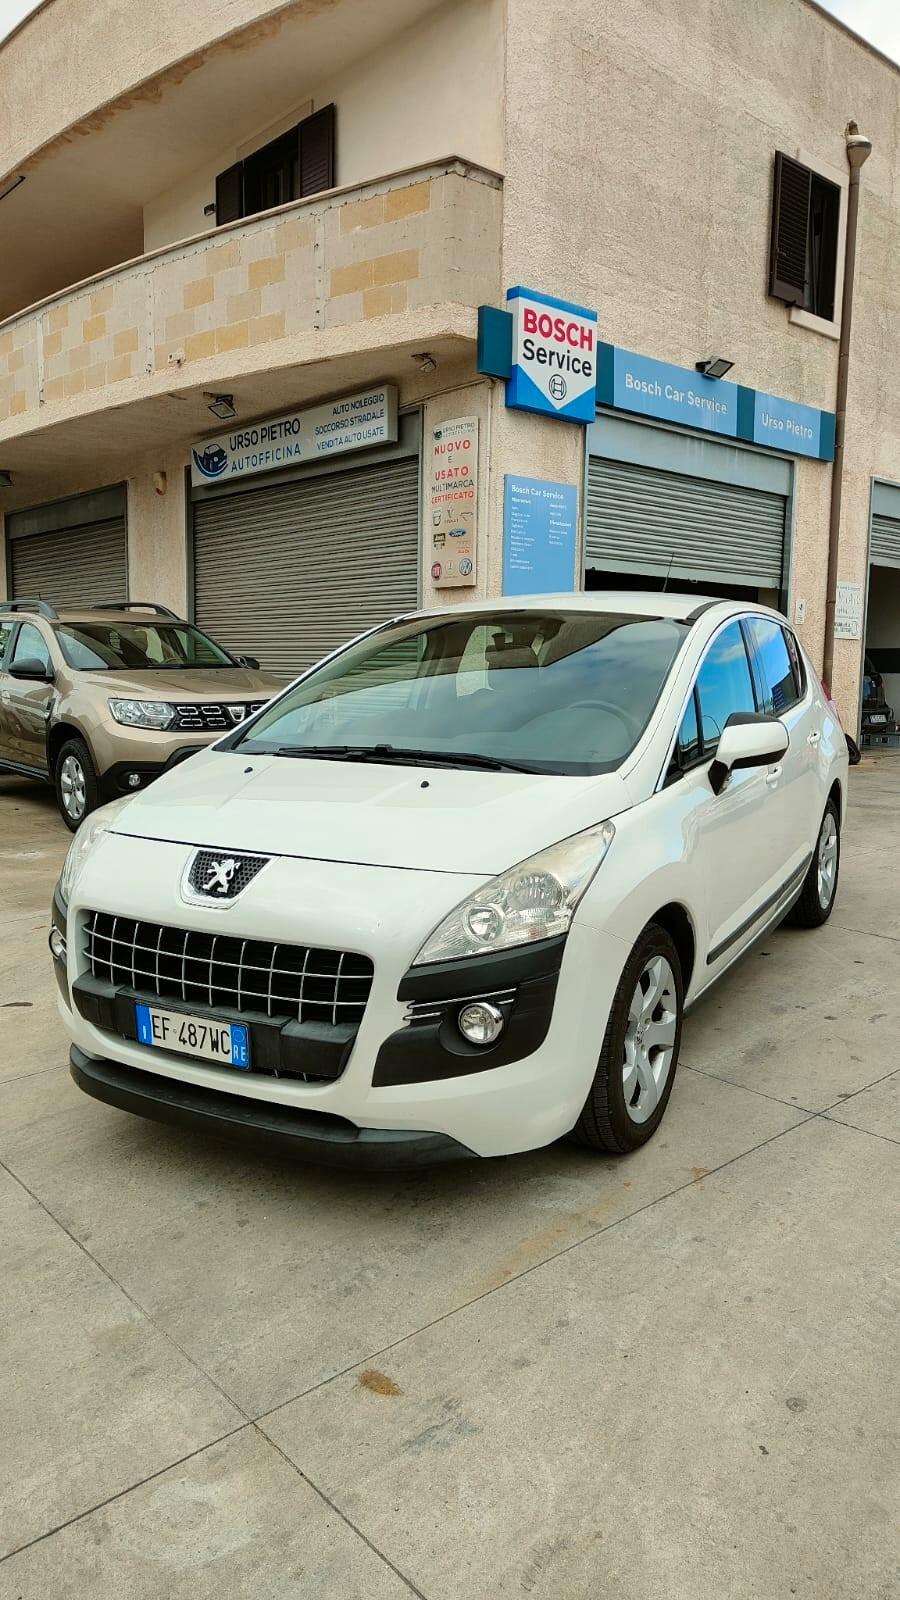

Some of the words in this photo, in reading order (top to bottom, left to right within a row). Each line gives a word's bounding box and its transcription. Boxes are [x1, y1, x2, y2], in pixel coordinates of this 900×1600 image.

[523, 308, 593, 352] BOSCH
[522, 338, 593, 378] Service
[332, 403, 350, 416] AUTO
[350, 393, 385, 411] NOLEGGIO
[624, 373, 662, 397] Bosch
[664, 384, 685, 403] Car
[687, 391, 729, 415] Service
[229, 430, 259, 452] URSO
[260, 417, 301, 444] PIETRO
[314, 418, 350, 436] SOCCORSO
[349, 408, 385, 426] STRADALE
[761, 412, 784, 431] Urso
[786, 419, 813, 439] Pietro
[316, 437, 344, 451] VENDITA
[344, 432, 362, 444] AUTO
[362, 426, 385, 440] USATE
[434, 439, 471, 456] NUOVO
[231, 443, 301, 472] AUTOFFICINA
[447, 455, 453, 464] E
[435, 465, 469, 481] USATO
[431, 479, 475, 494] MULTIMARCA
[431, 490, 475, 505] CERTIFICATO
[511, 484, 530, 495] Bosch
[530, 488, 542, 497] Car
[542, 490, 564, 500] Service
[152, 1015, 170, 1040] EF
[178, 1022, 230, 1054] 487WC
[233, 1045, 246, 1061] RE
